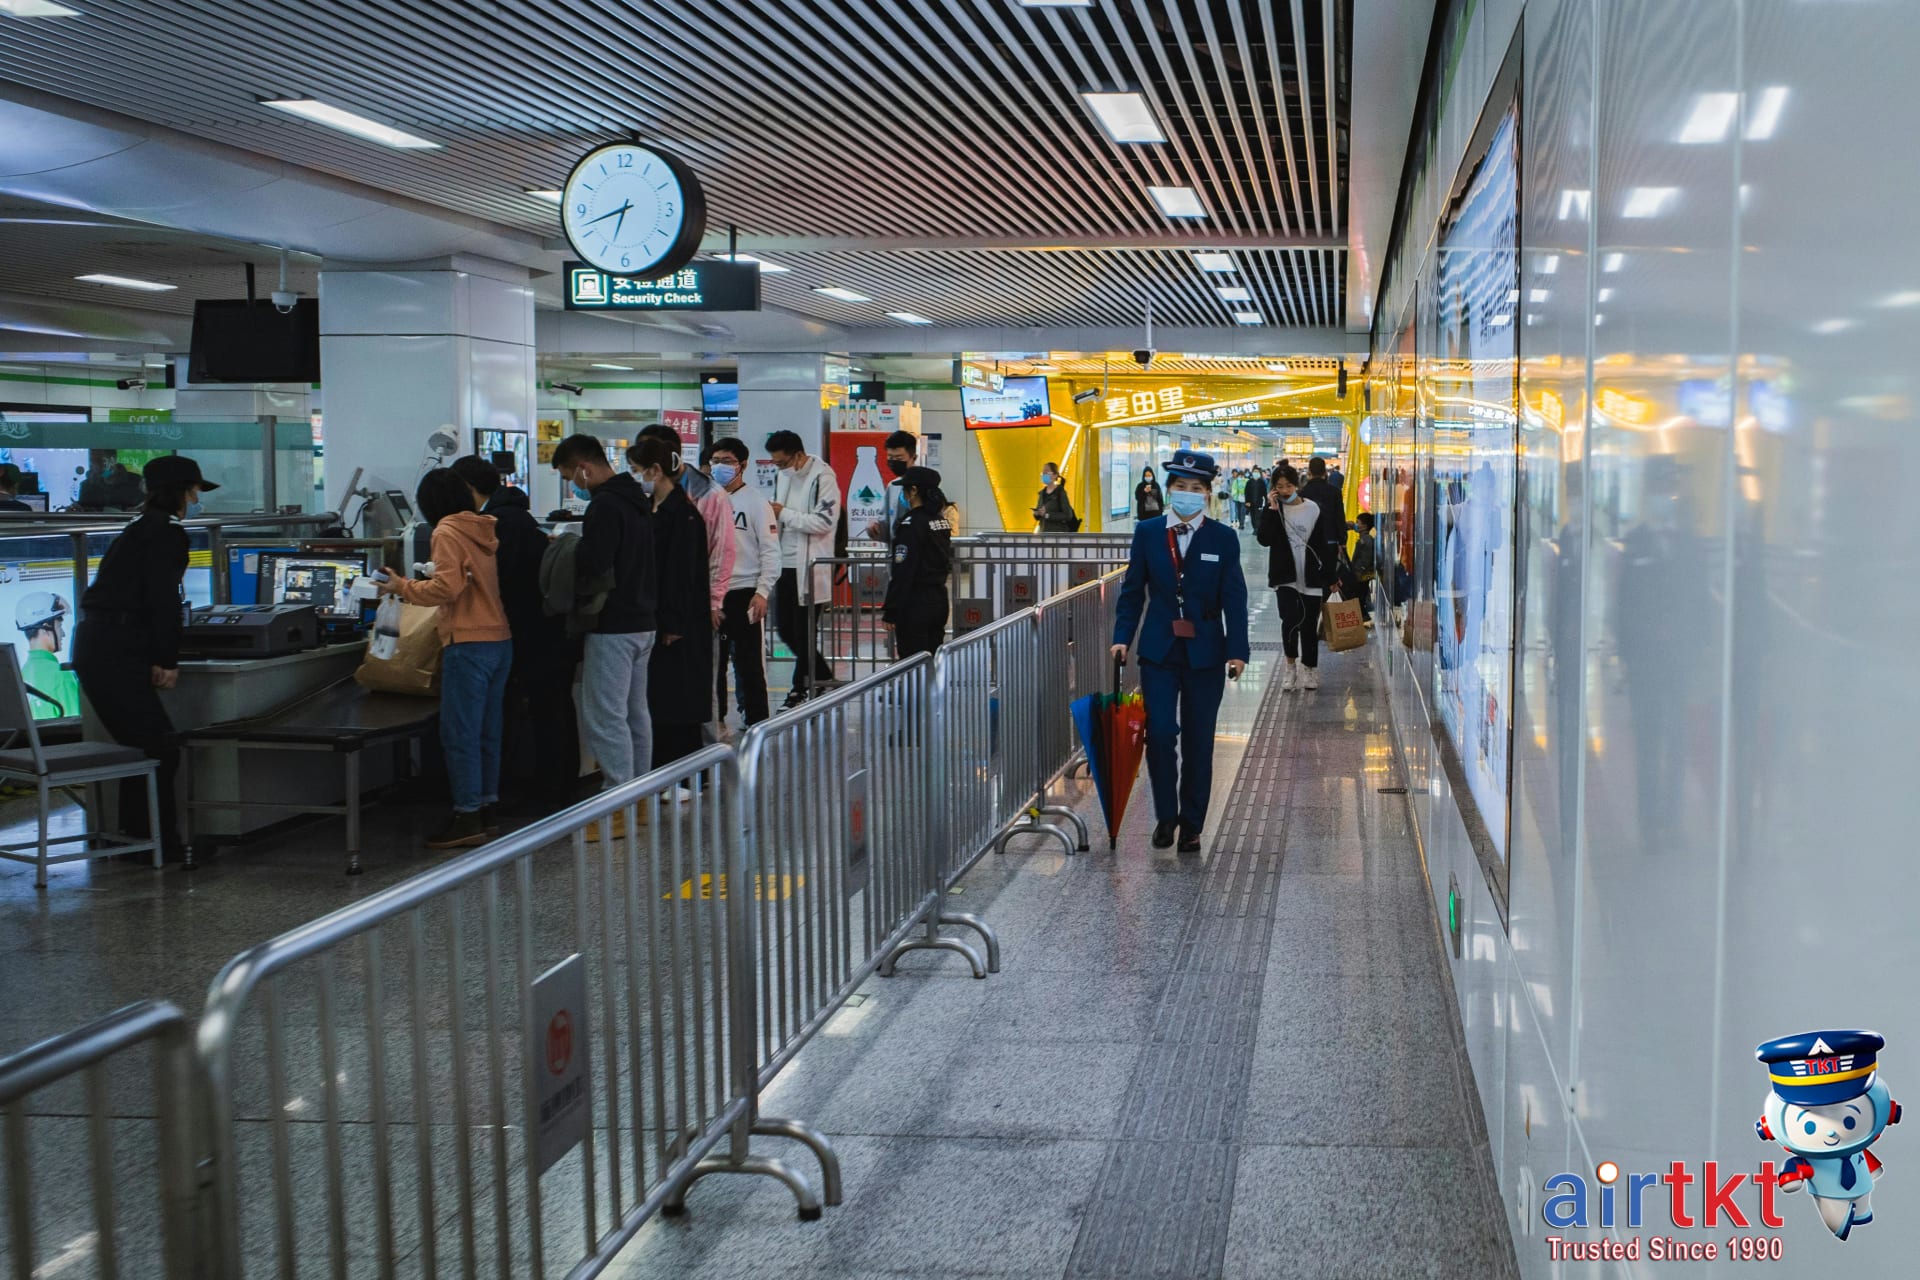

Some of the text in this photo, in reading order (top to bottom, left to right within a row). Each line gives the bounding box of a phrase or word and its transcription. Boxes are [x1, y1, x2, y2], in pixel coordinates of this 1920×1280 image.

[617, 153, 633, 168] 12
[577, 203, 586, 217] 9
[665, 203, 674, 217] 3
[620, 253, 629, 267] 6
[612, 292, 702, 305] Security Check
[1104, 386, 1185, 420] 麦田里
